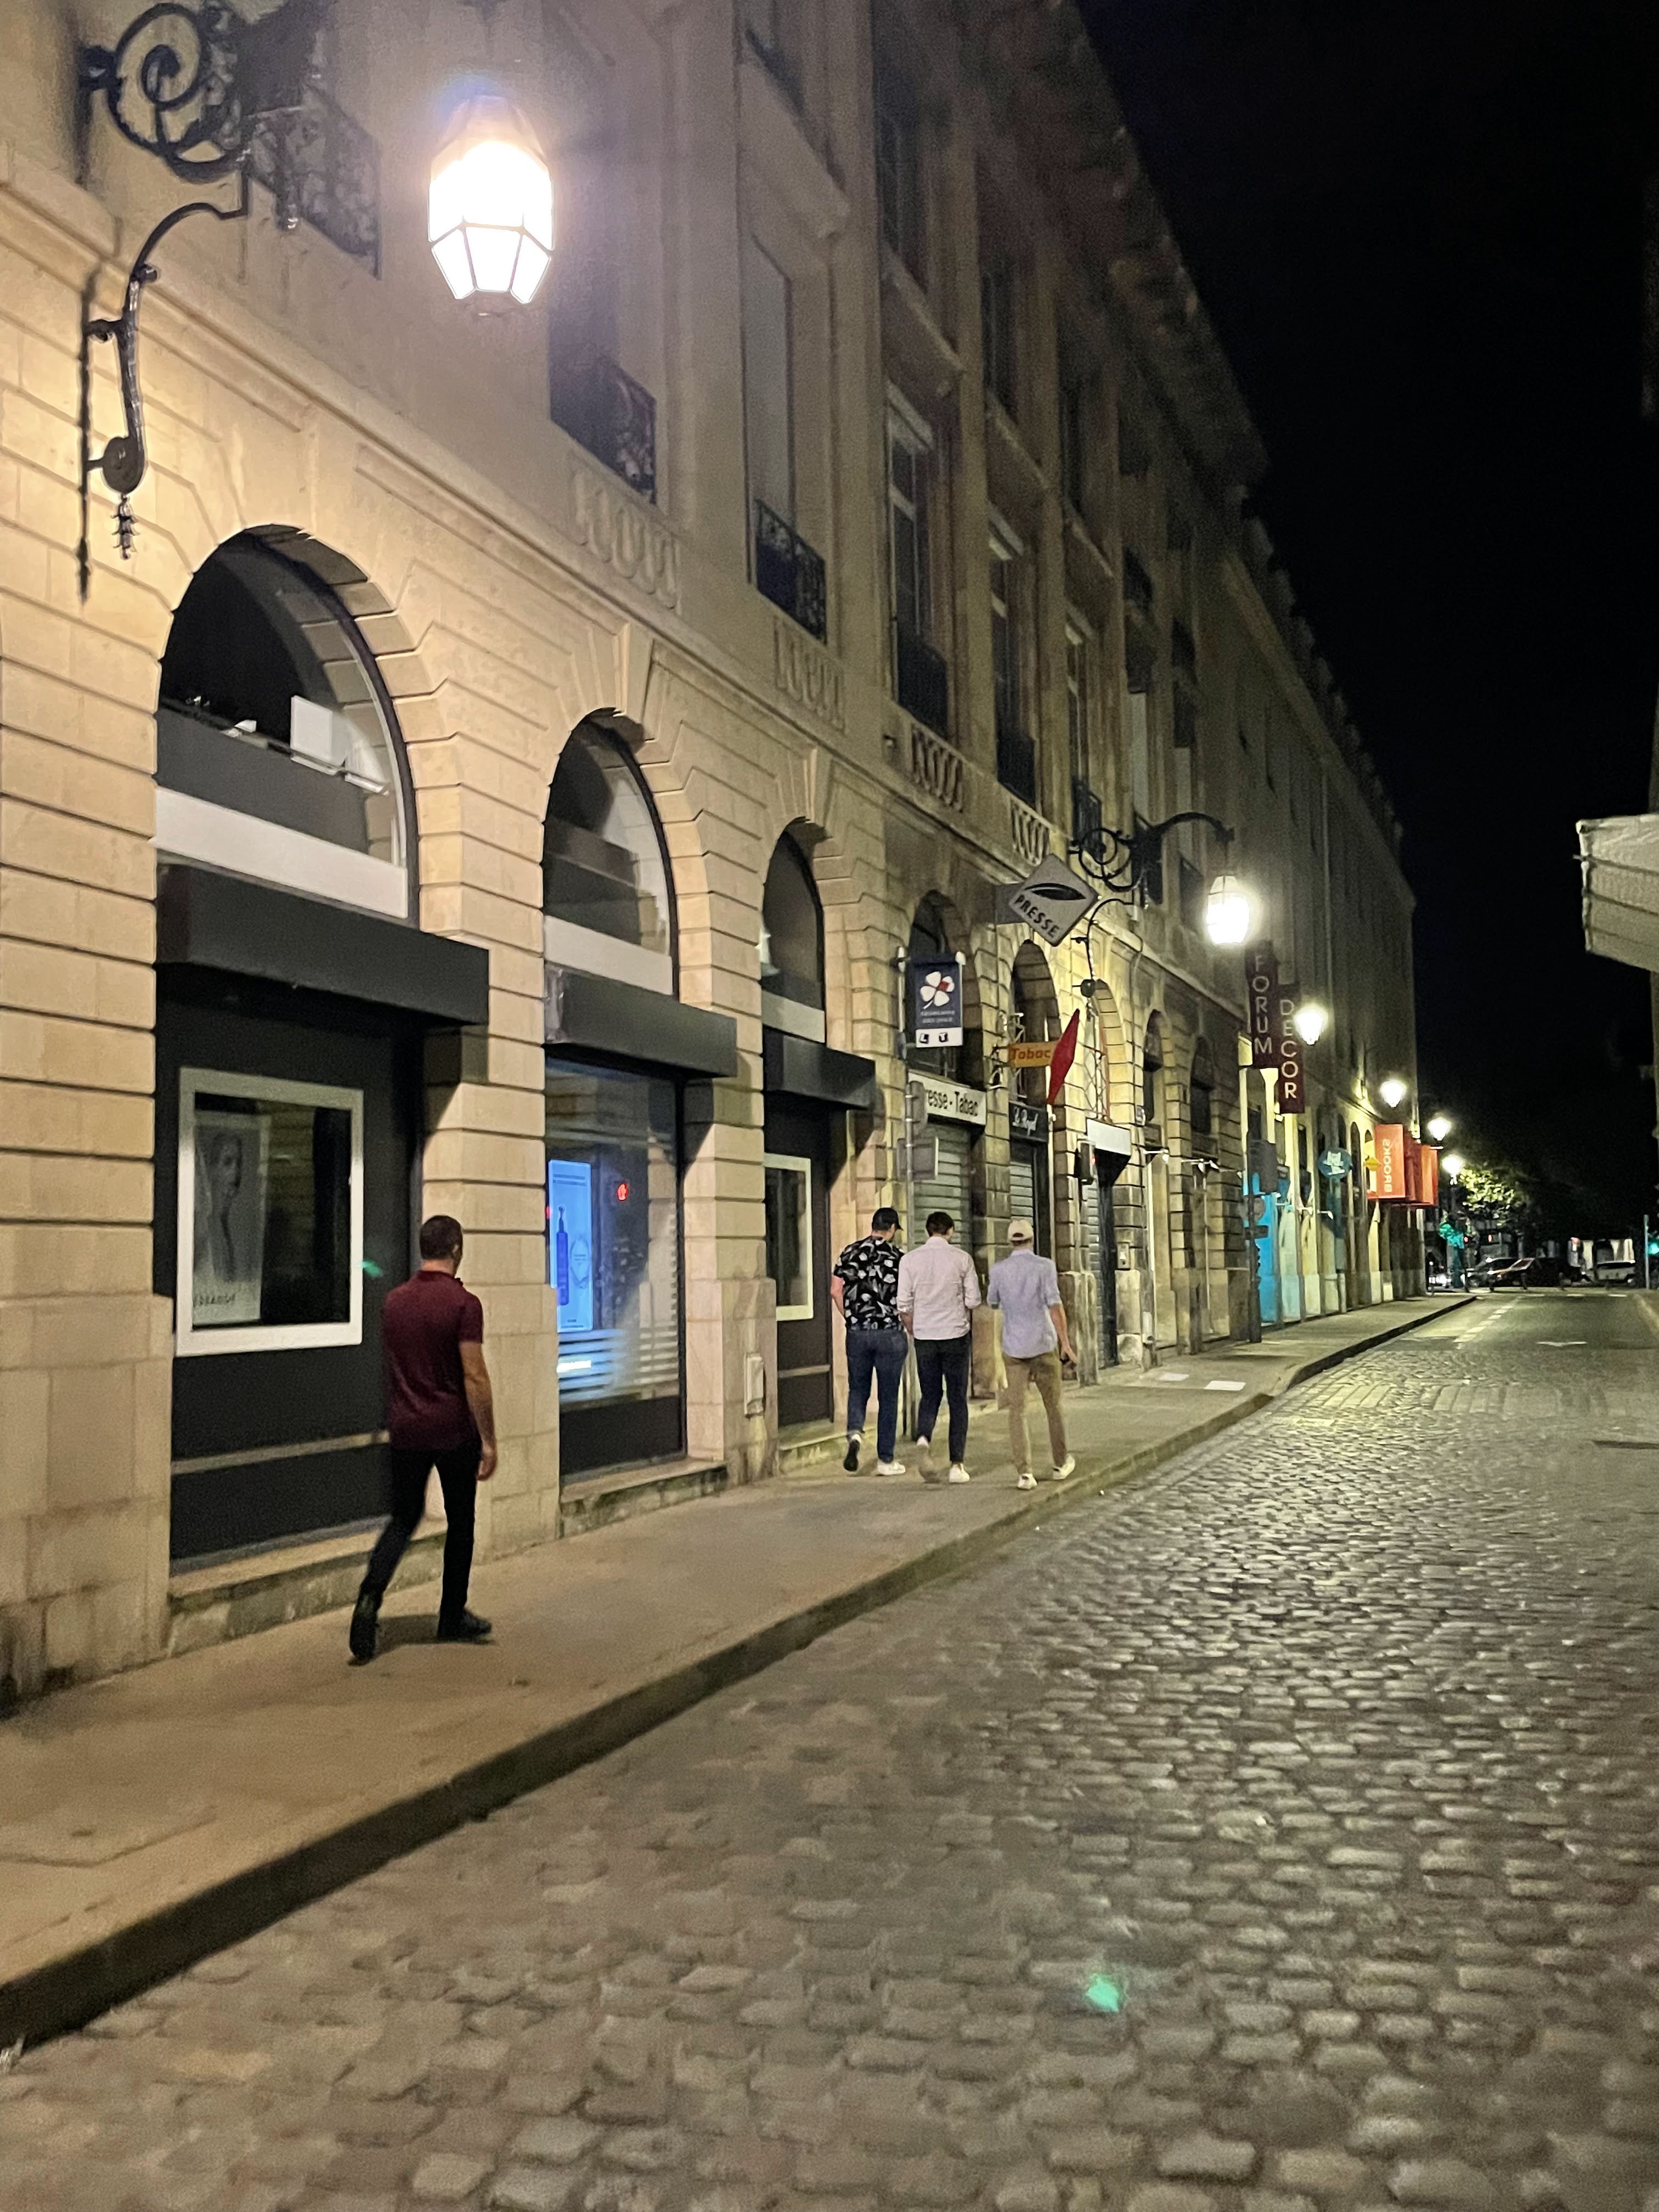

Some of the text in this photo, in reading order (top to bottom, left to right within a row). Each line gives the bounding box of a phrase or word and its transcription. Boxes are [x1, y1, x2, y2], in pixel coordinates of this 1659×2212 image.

[1014, 894, 1059, 938] PRESSE
[1252, 955, 1273, 1054] FORUM
[1011, 1047, 1051, 1060] Tabac
[1279, 998, 1299, 1099] DECOR
